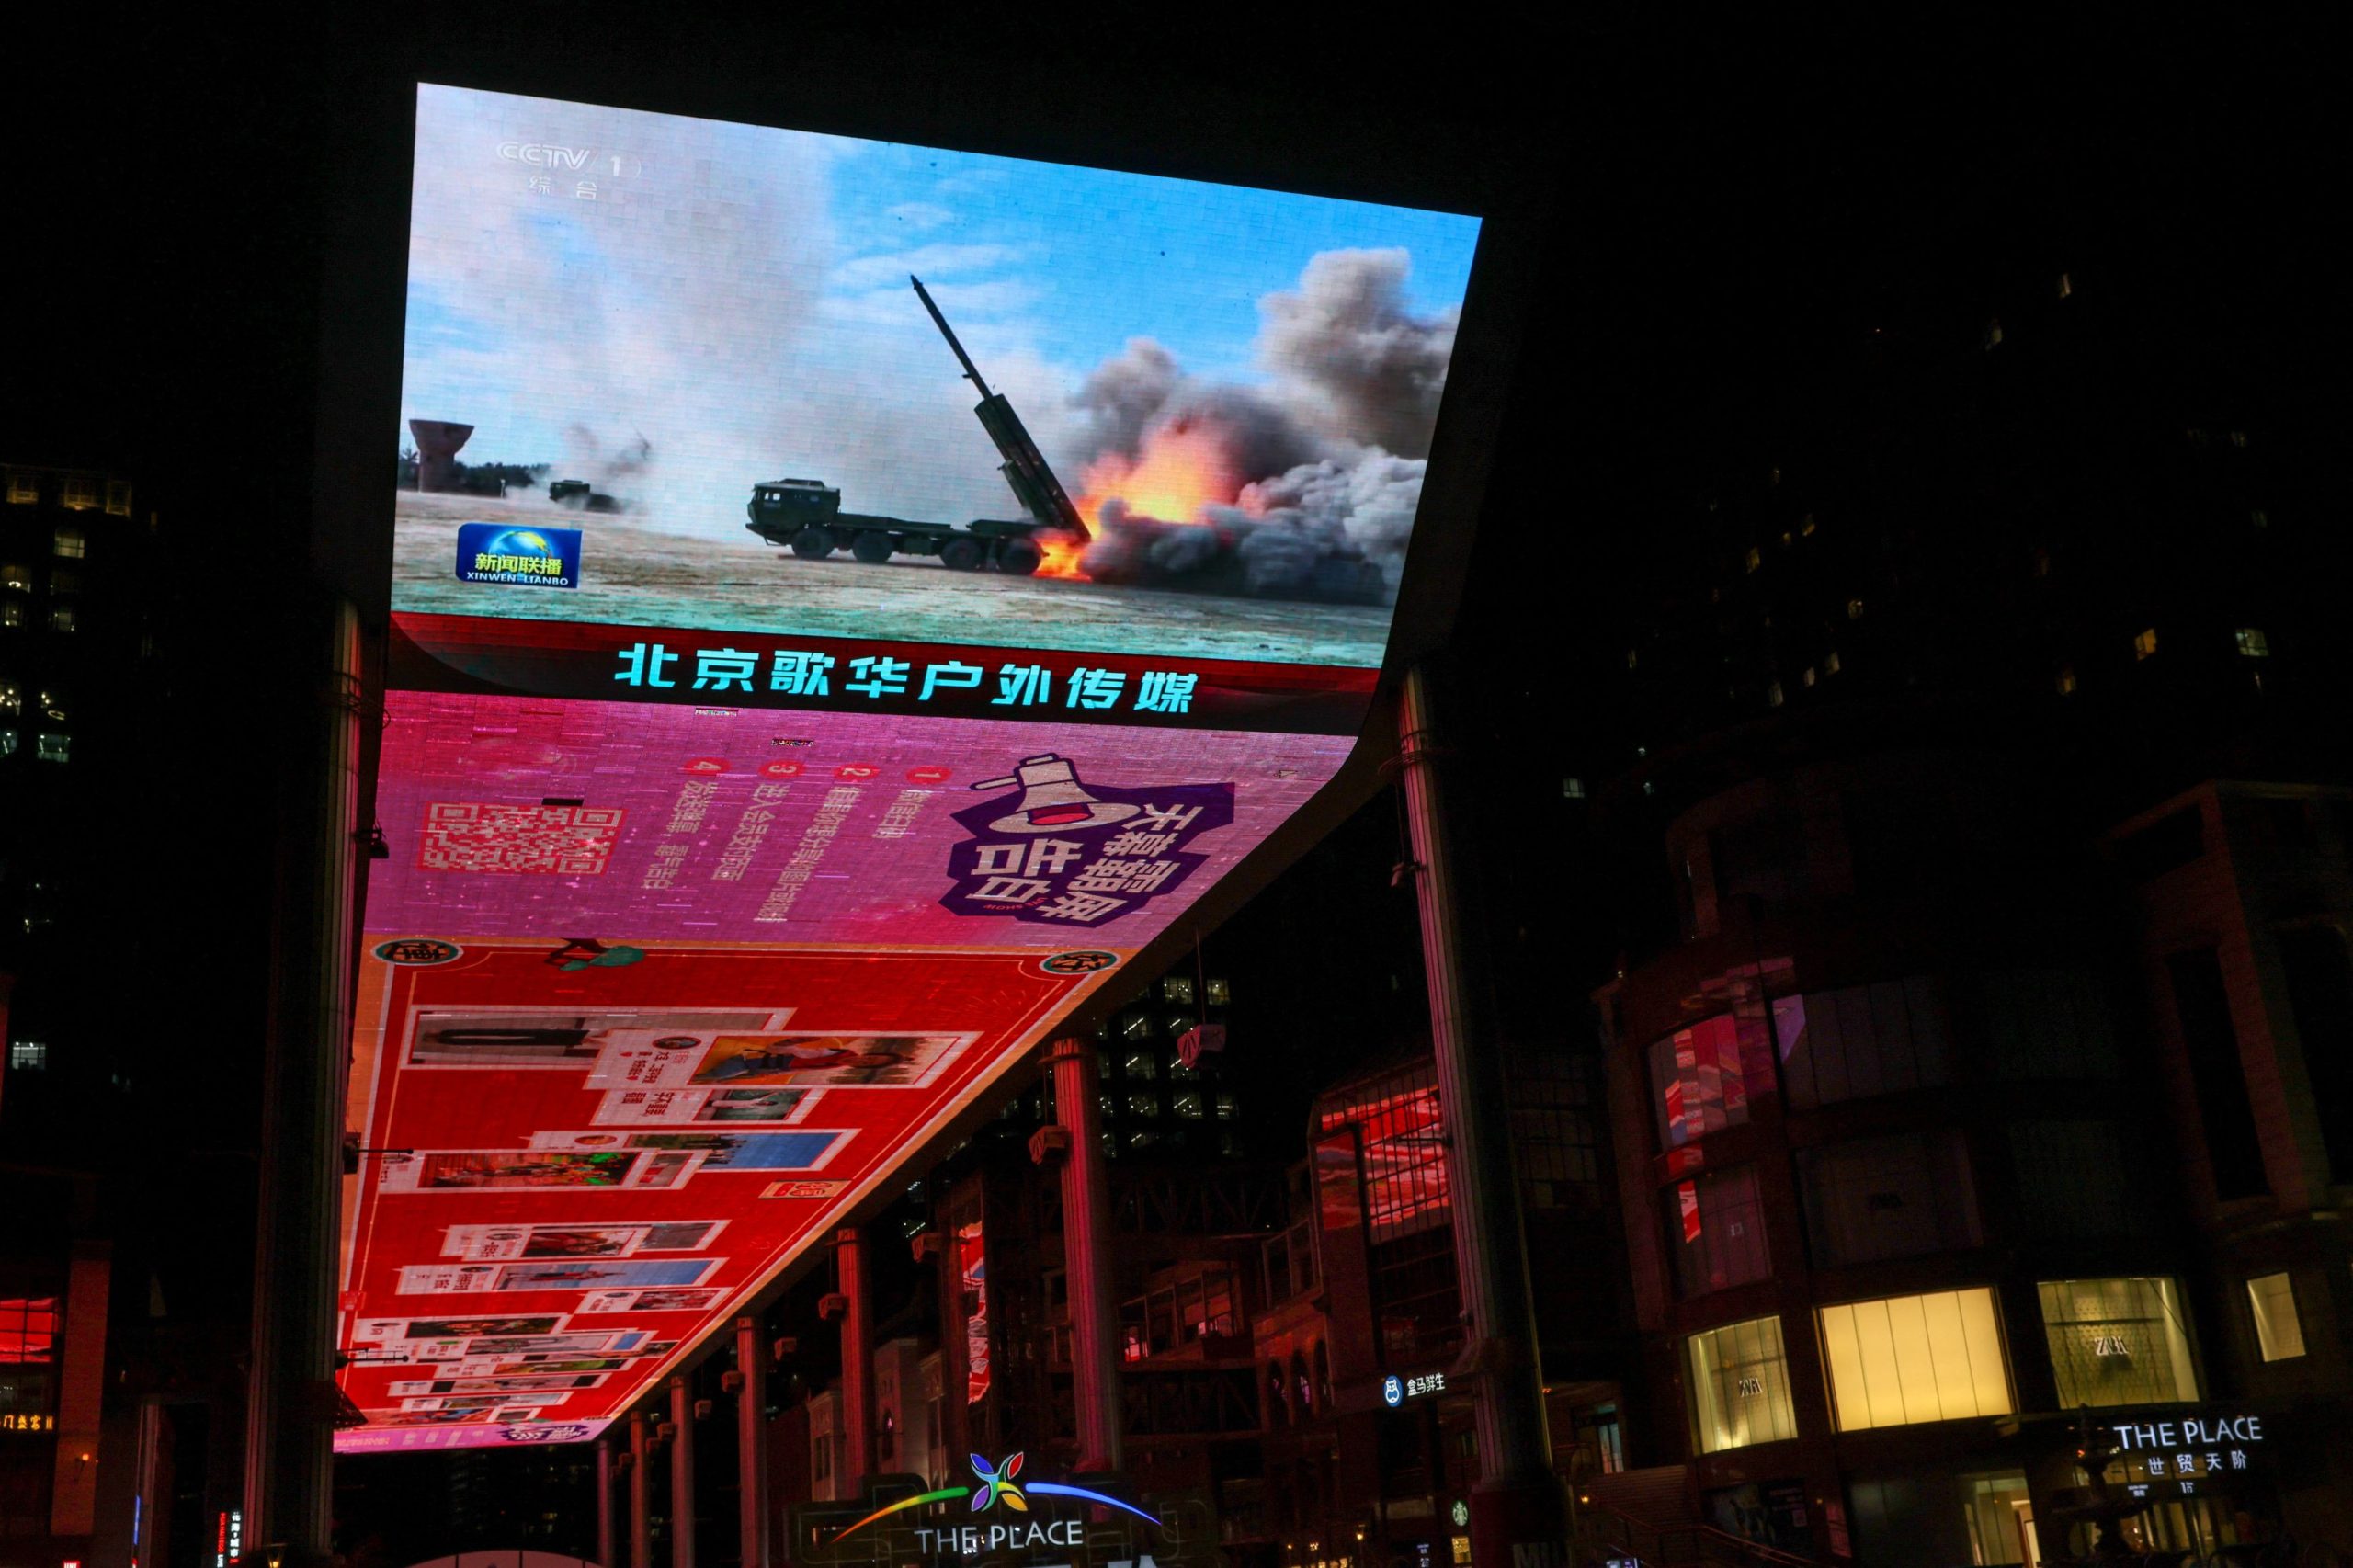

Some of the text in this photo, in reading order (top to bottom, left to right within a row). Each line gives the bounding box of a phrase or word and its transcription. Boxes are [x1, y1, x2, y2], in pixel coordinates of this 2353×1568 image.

[496, 141, 620, 176] CCTV 1
[530, 176, 597, 199] 综合
[467, 572, 569, 585] XINWEN LIANBO
[474, 552, 563, 575] 新闻联播
[614, 643, 1198, 713] 北京歌华户外传媒
[964, 838, 1084, 903] 告白
[1036, 802, 1205, 922] 天幕霸屏
[1406, 1372, 1446, 1396] 盒马鲜生
[2114, 1416, 2264, 1449] THE PLACE
[2147, 1449, 2248, 1476] 世贸天阶
[915, 1520, 1083, 1554] THE PLACE
